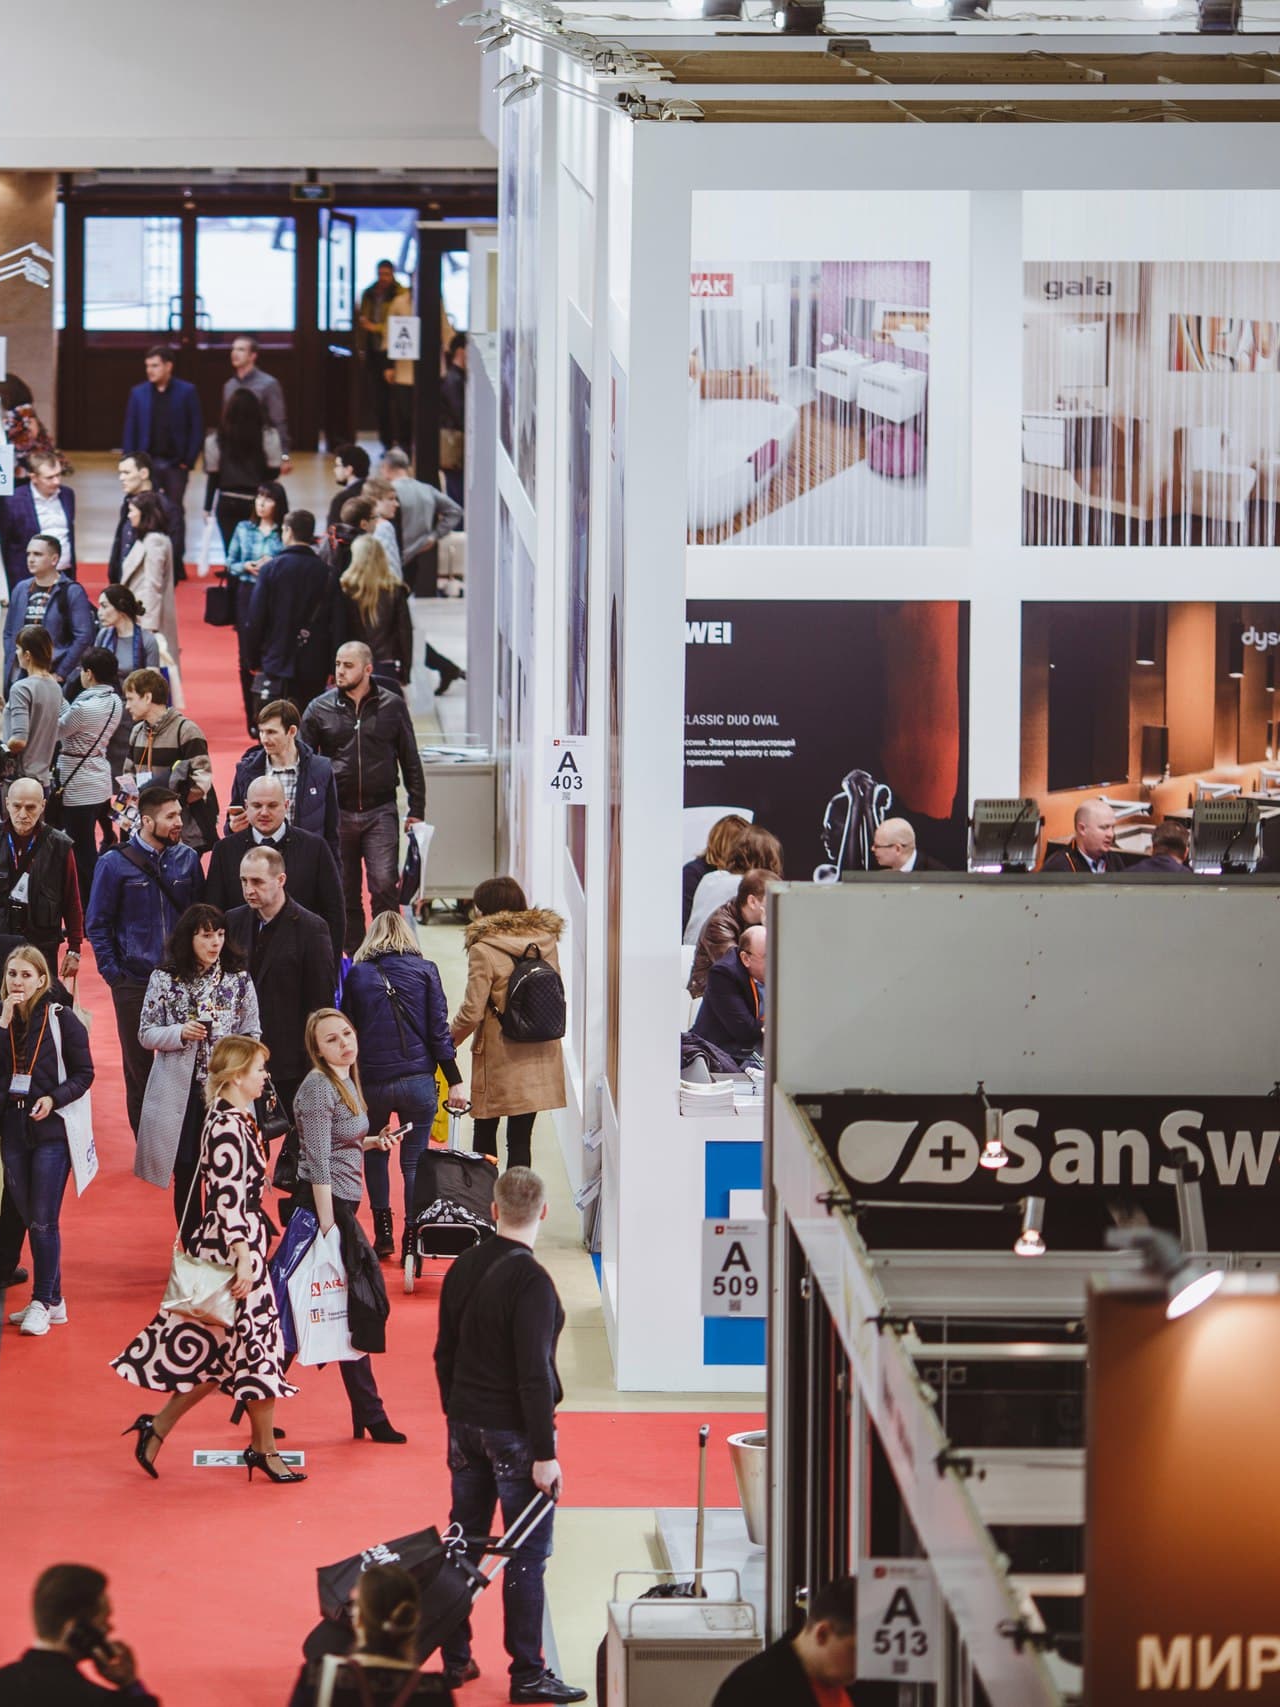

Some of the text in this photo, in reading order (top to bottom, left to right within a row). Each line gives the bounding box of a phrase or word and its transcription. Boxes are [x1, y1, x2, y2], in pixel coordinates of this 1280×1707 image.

[1044, 276, 1111, 300] gala
[398, 325, 410, 339] A
[685, 621, 732, 644] WEI
[1241, 626, 1280, 651] dys
[684, 714, 780, 725] LASSIC DUO OVAL
[557, 751, 578, 773] A
[550, 775, 583, 790] 403
[996, 1108, 1280, 1186] SanSw
[721, 1241, 751, 1272] A
[713, 1276, 759, 1296] 509
[882, 1586, 921, 1626] A
[873, 1629, 929, 1657] 513
[1137, 1633, 1280, 1691] МИР
